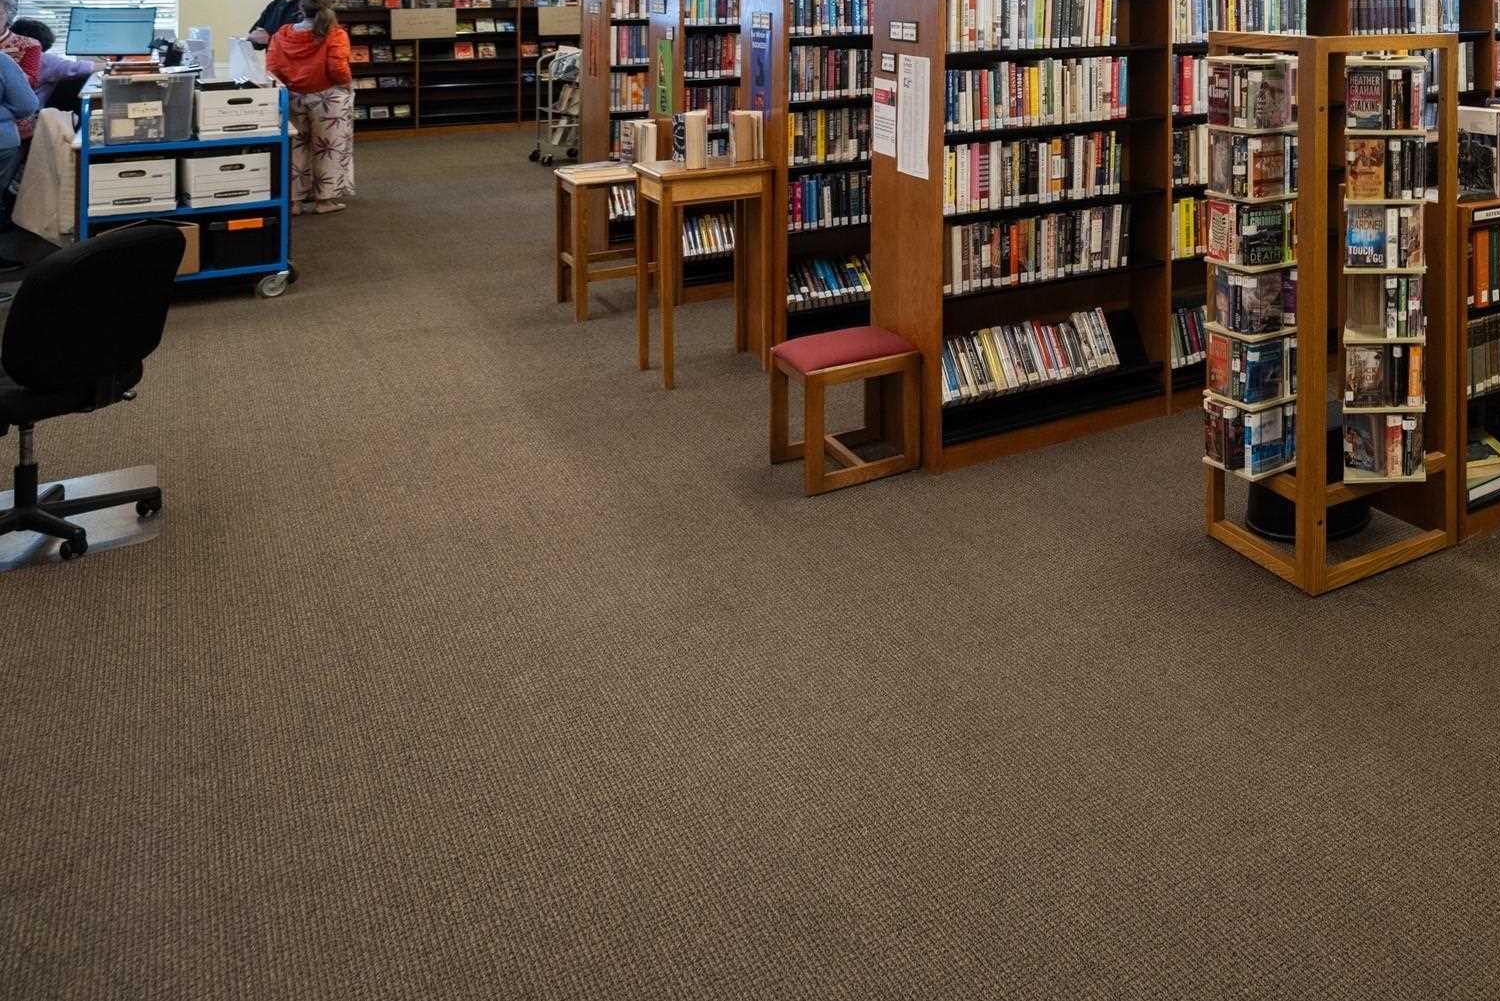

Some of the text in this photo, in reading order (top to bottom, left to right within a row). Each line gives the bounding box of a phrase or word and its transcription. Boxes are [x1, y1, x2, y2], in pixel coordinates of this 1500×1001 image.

[1349, 75, 1381, 85] HEATHER
[1349, 85, 1381, 97] GRAHAM
[1357, 208, 1373, 218] LISA
[1250, 250, 1281, 262] DEATH
[1348, 246, 1374, 256] TOUCH
